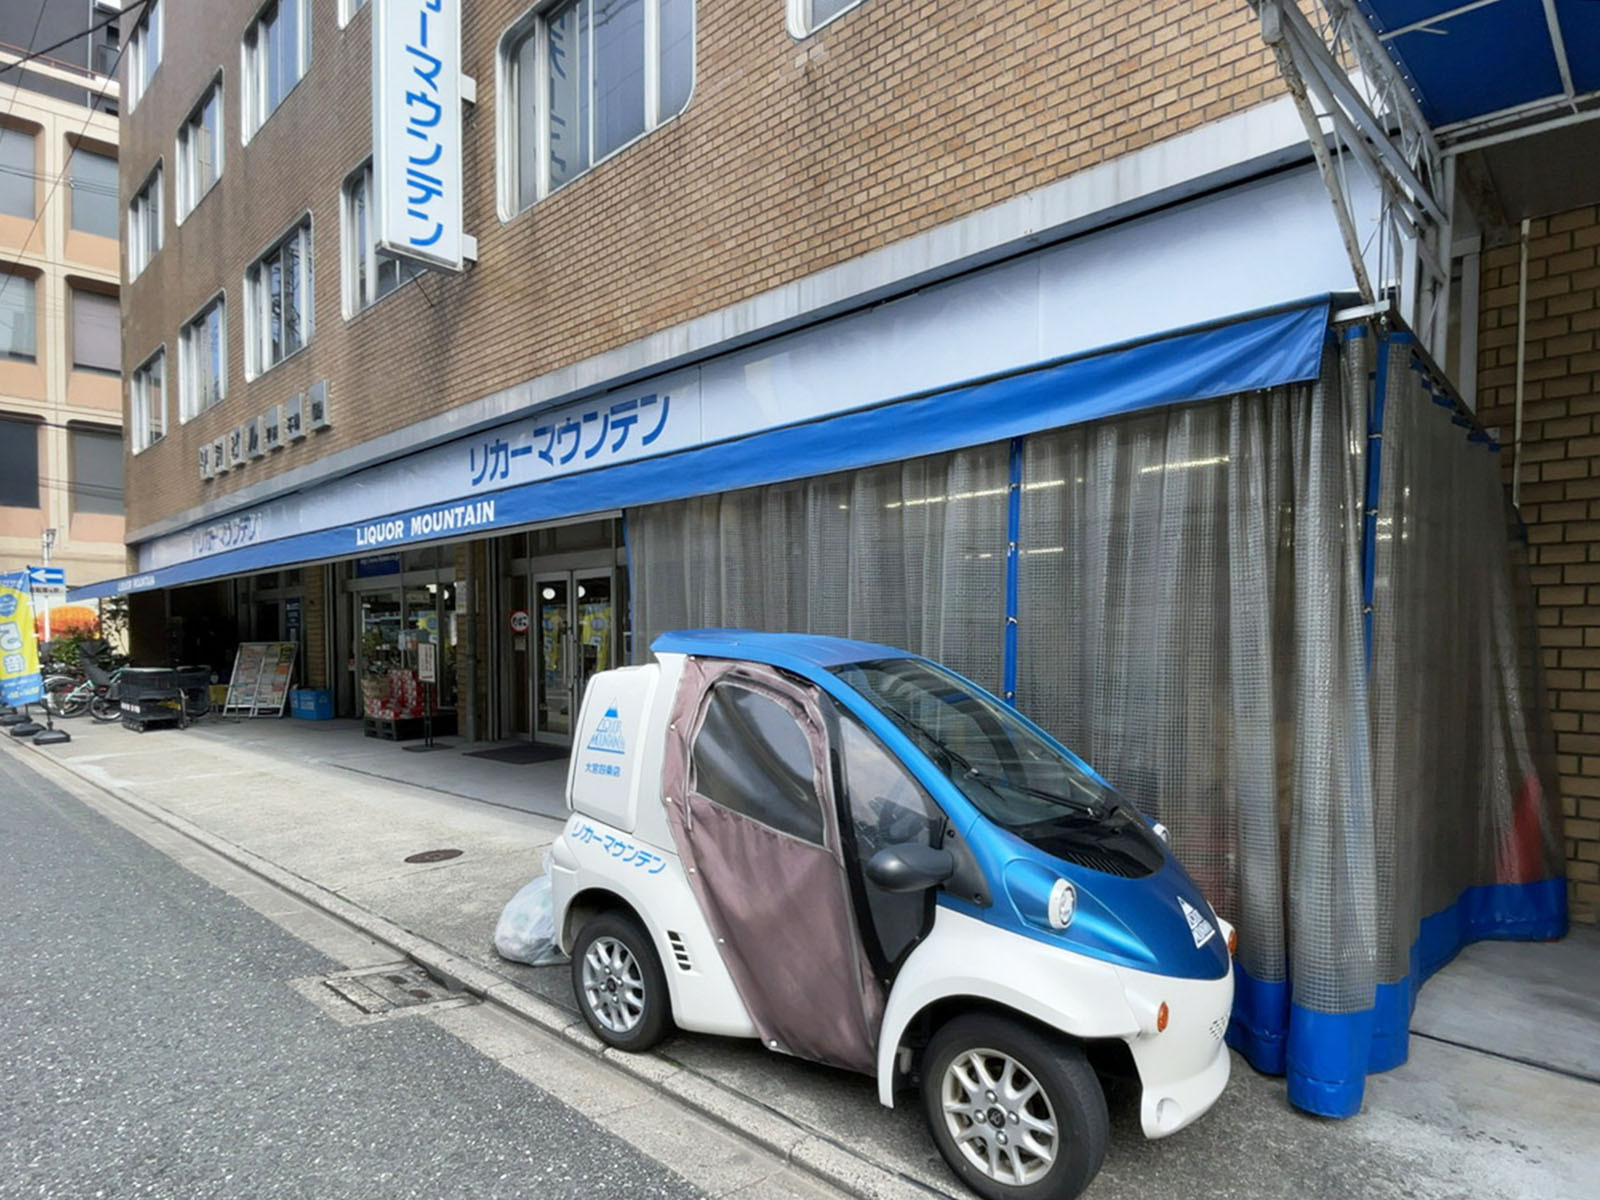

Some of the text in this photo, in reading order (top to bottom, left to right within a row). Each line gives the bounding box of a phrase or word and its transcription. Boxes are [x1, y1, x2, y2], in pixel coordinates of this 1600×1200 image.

[405, 0, 443, 246] ーマウンテン
[470, 395, 670, 487] リカーマウンテン
[356, 500, 496, 546] LIQUOR MOUNTAIN
[571, 821, 666, 875] リカーマウンテン
